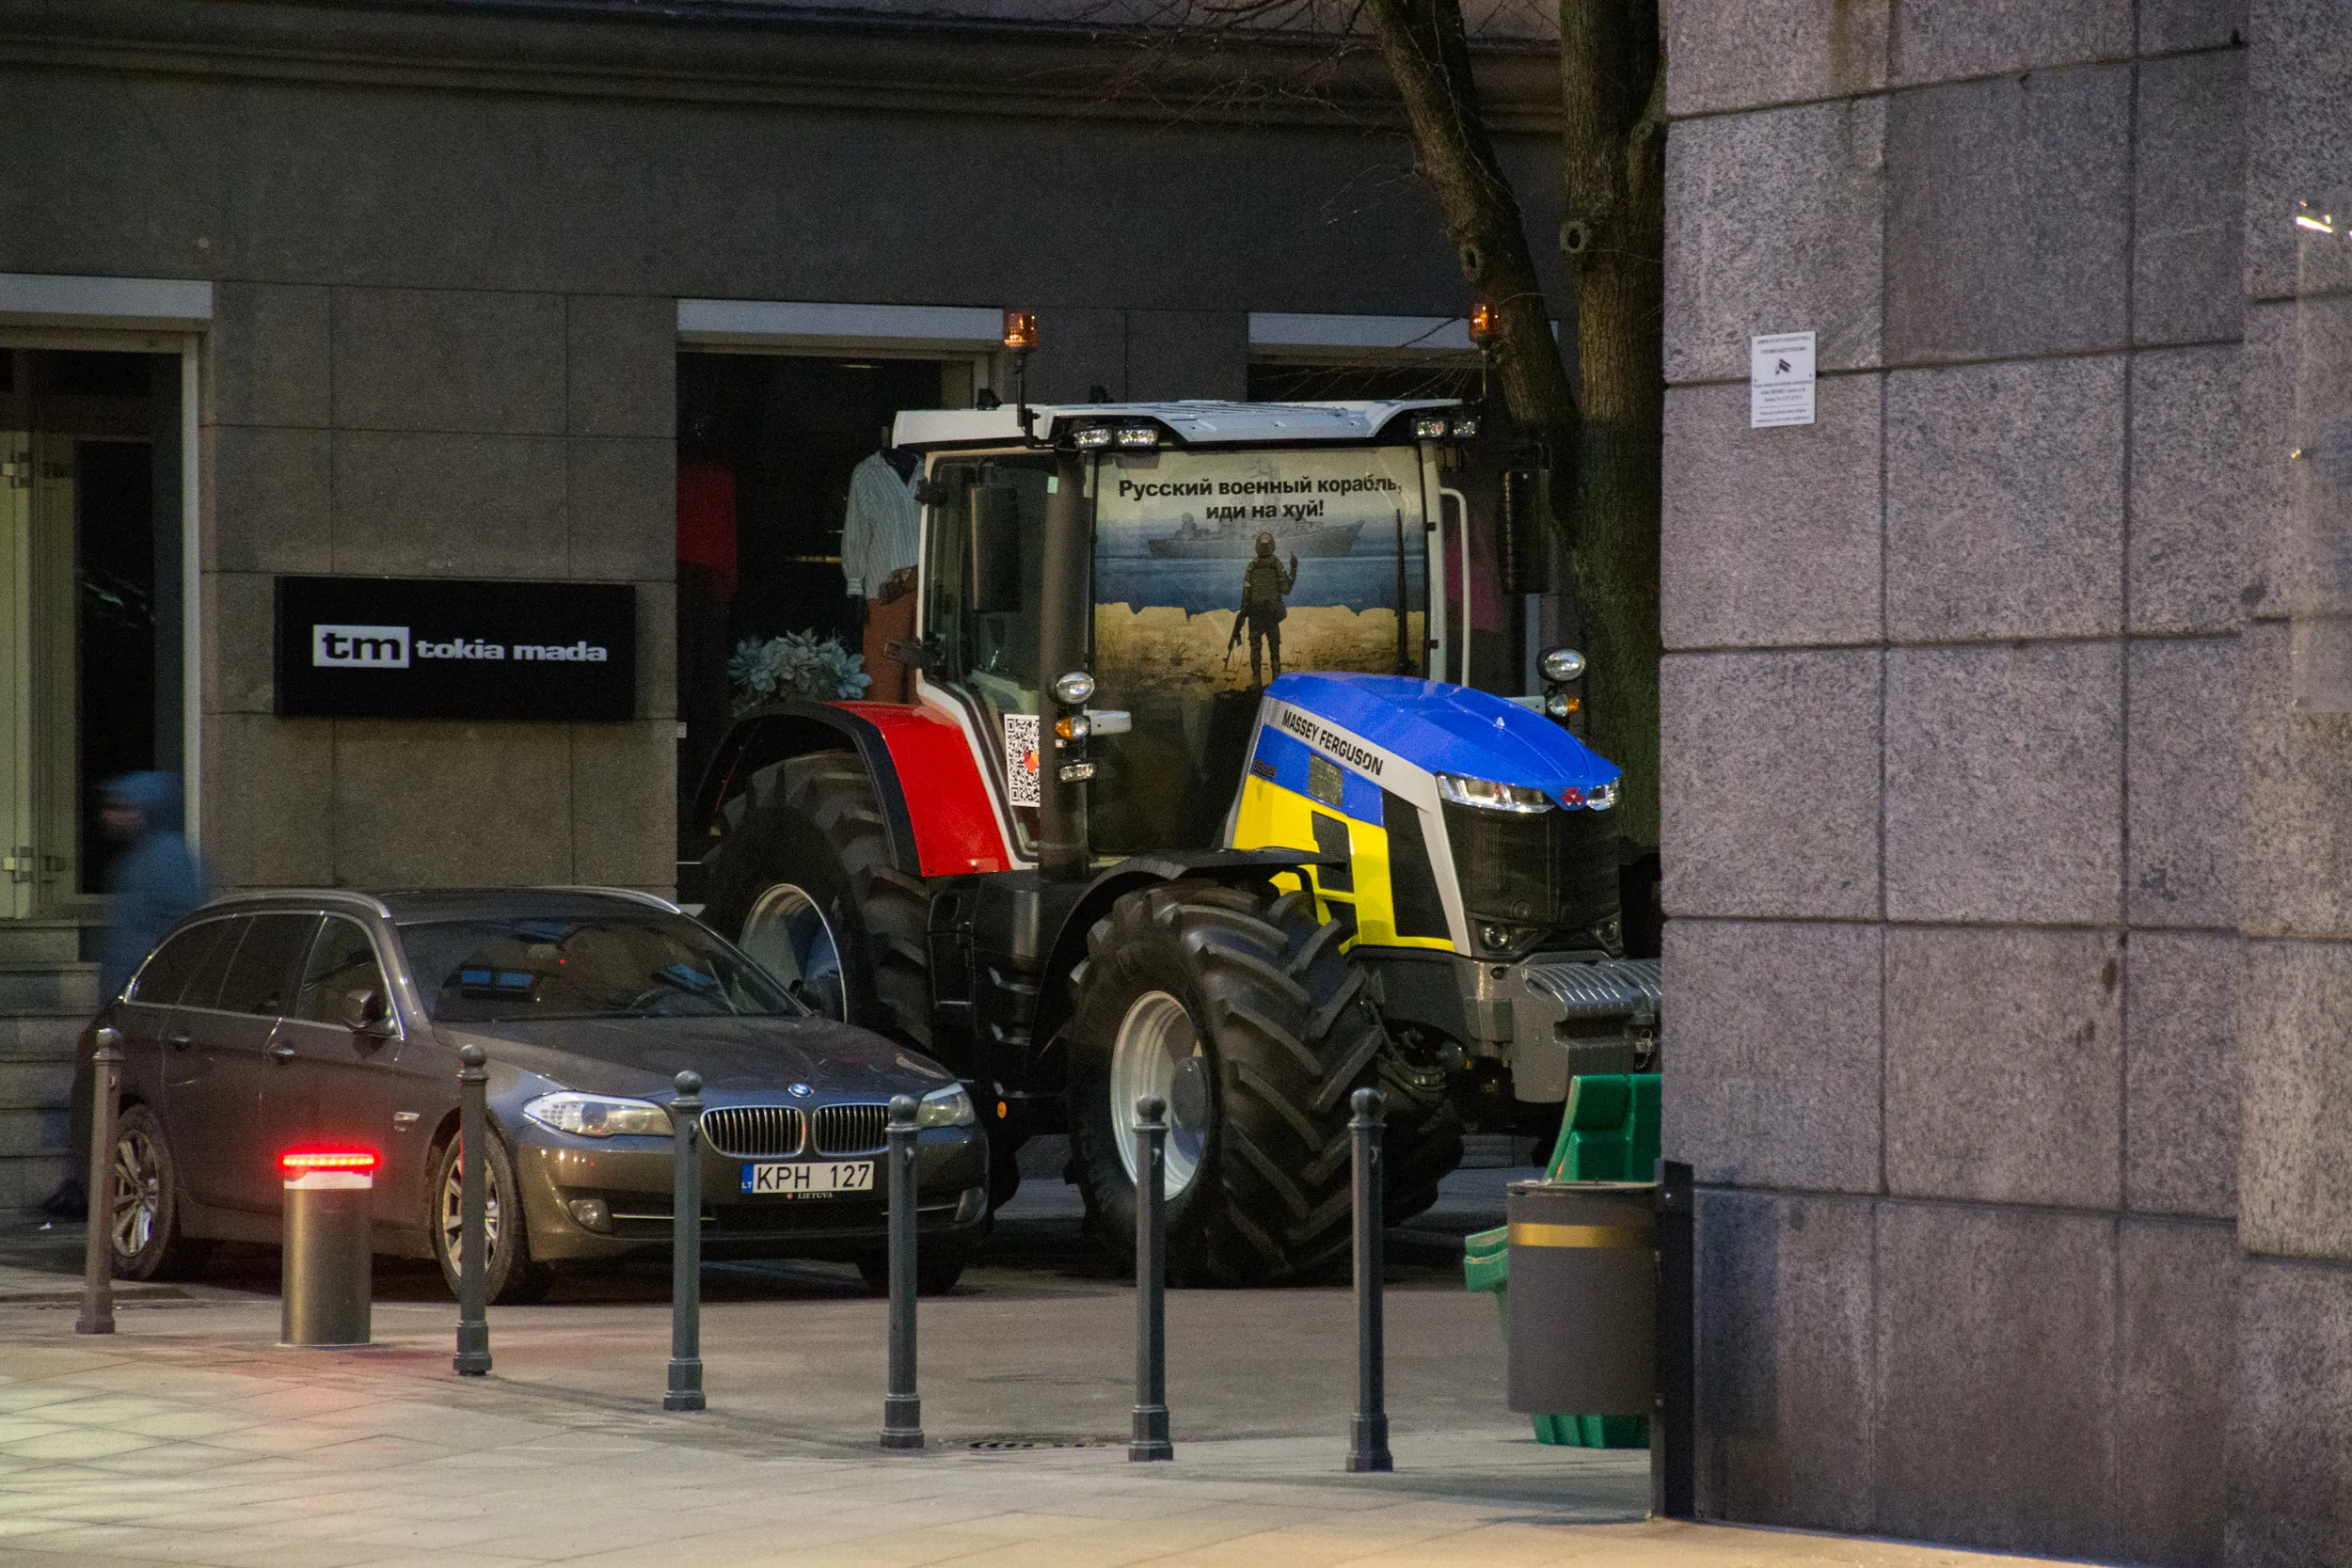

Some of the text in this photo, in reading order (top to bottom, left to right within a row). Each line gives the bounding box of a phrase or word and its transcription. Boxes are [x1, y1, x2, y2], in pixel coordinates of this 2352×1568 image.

[1119, 473, 1403, 500] Русский военный корабль,
[1206, 499, 1325, 522] иди на хуй!
[322, 631, 402, 660] tm
[415, 638, 608, 662] tokia mada
[1281, 709, 1321, 742] MASSEY
[1319, 729, 1384, 776] FERGUSON
[741, 1180, 753, 1189] LT
[756, 1164, 871, 1190] KPH 127
[797, 1192, 834, 1200] LIETUVA
